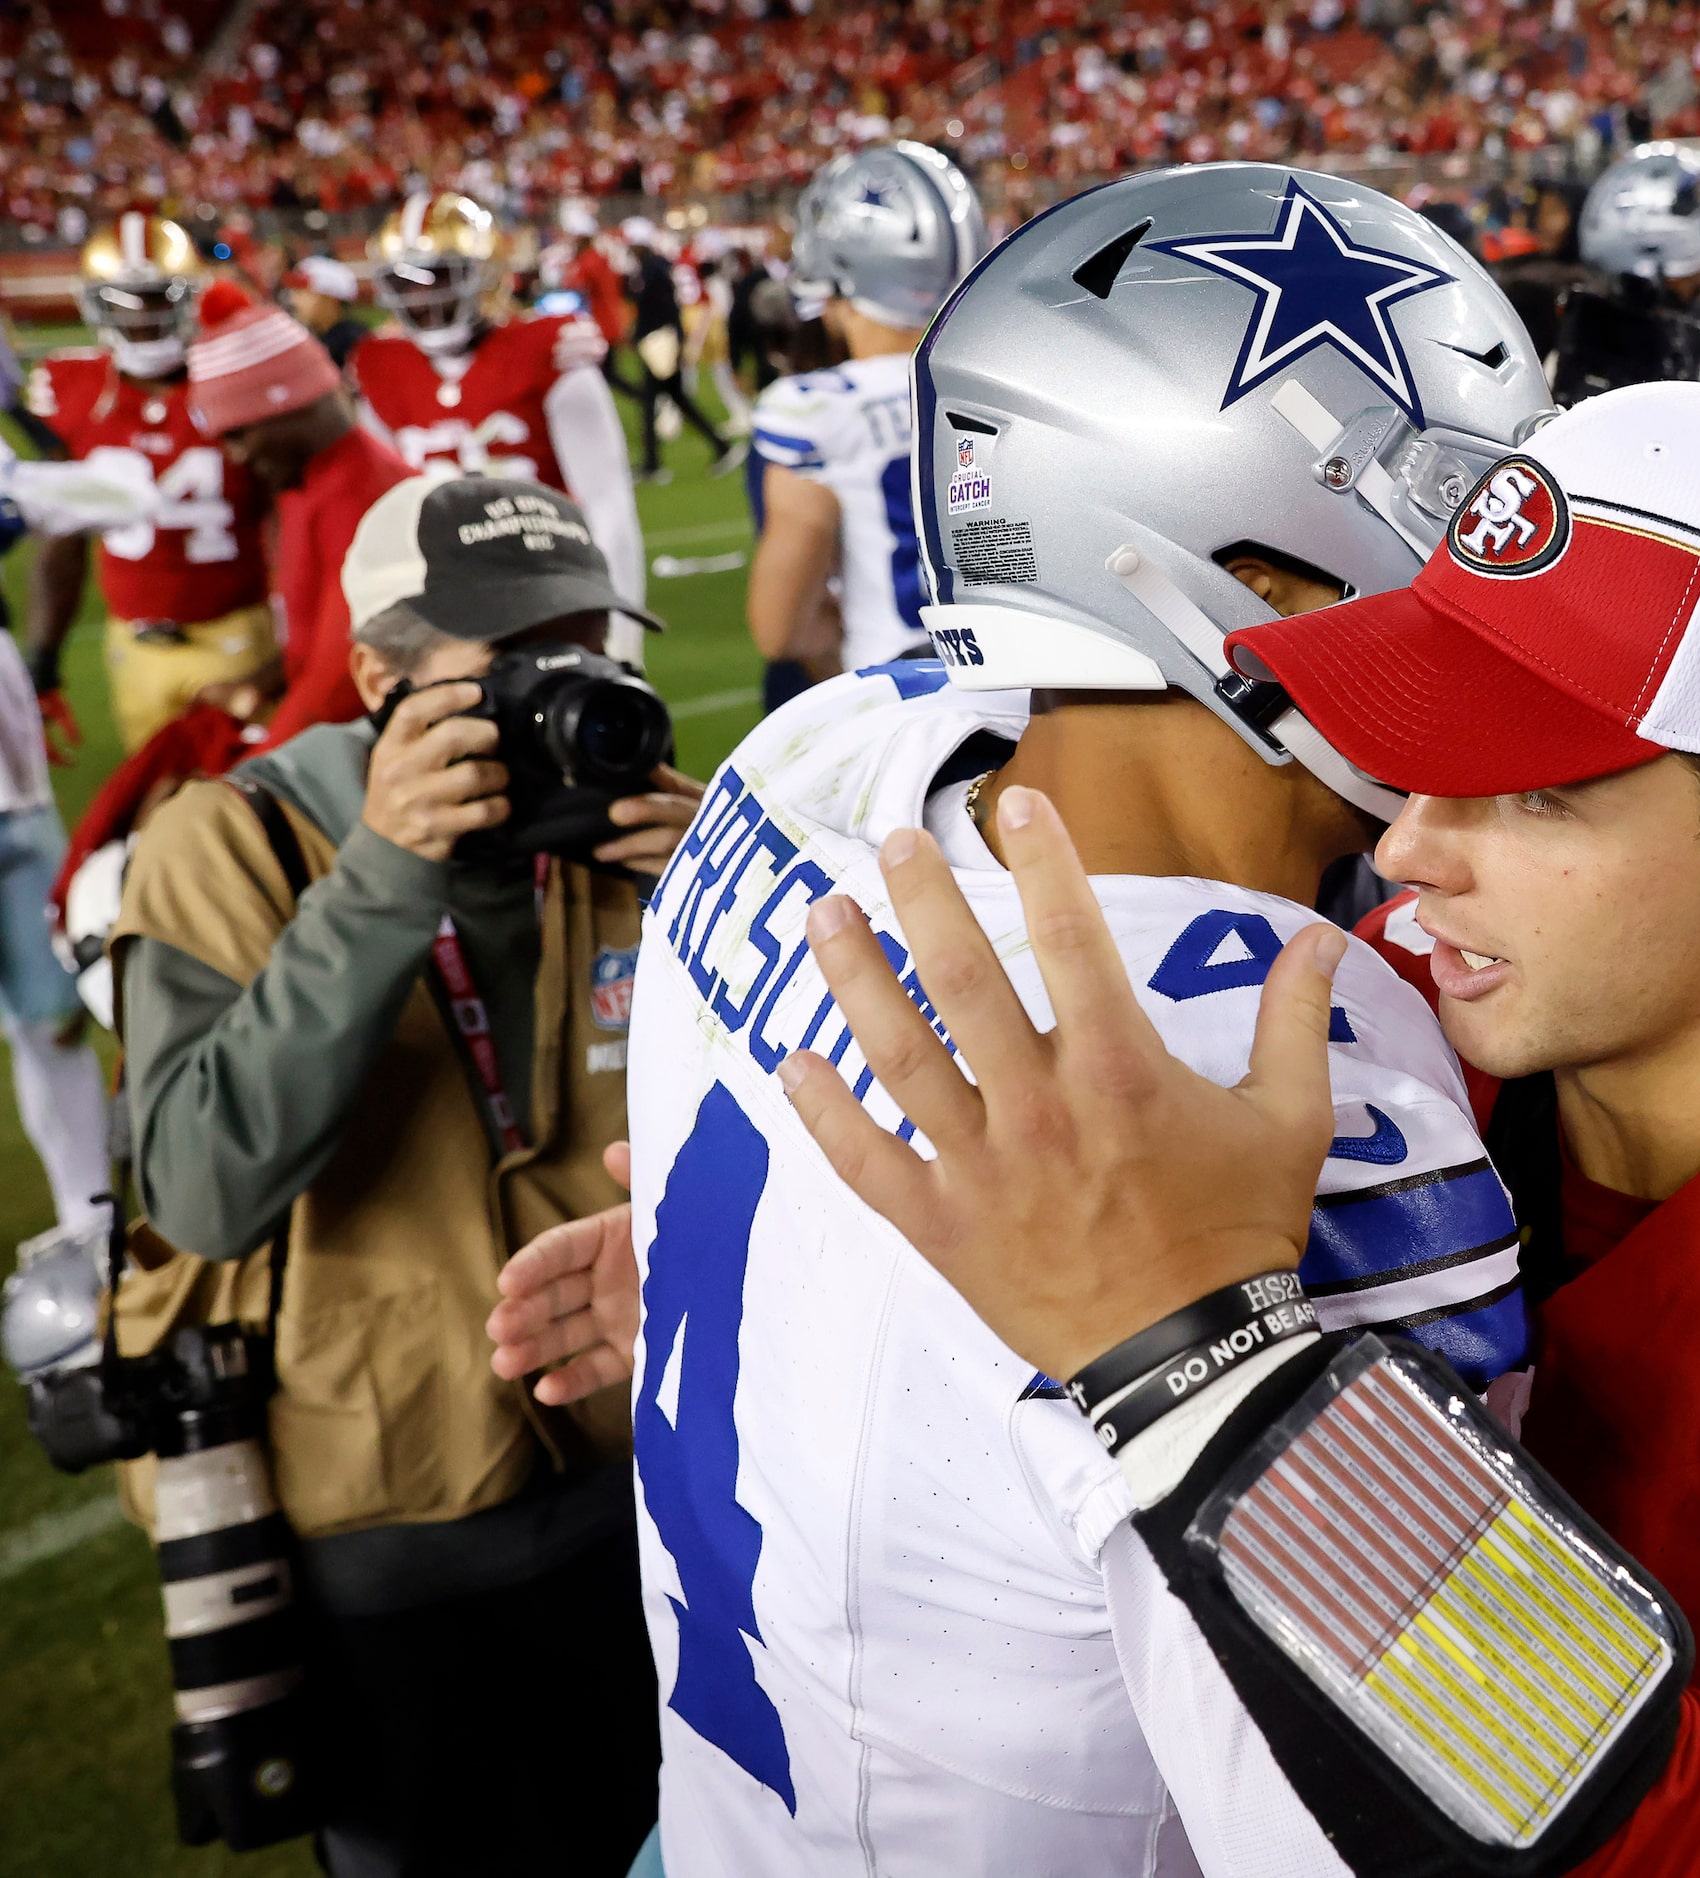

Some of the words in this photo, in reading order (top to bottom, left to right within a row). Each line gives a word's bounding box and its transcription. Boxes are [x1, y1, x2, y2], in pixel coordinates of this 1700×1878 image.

[959, 451, 974, 465] NFL
[953, 470, 983, 484] CRUCIAL
[949, 479, 991, 504] CATCH
[966, 518, 1006, 528] WARNING
[928, 628, 984, 666] OYS
[1165, 1356, 1208, 1397] DO
[1208, 1320, 1265, 1367] NOT
[1262, 1308, 1295, 1336] BE
[634, 1079, 797, 1820] 4
